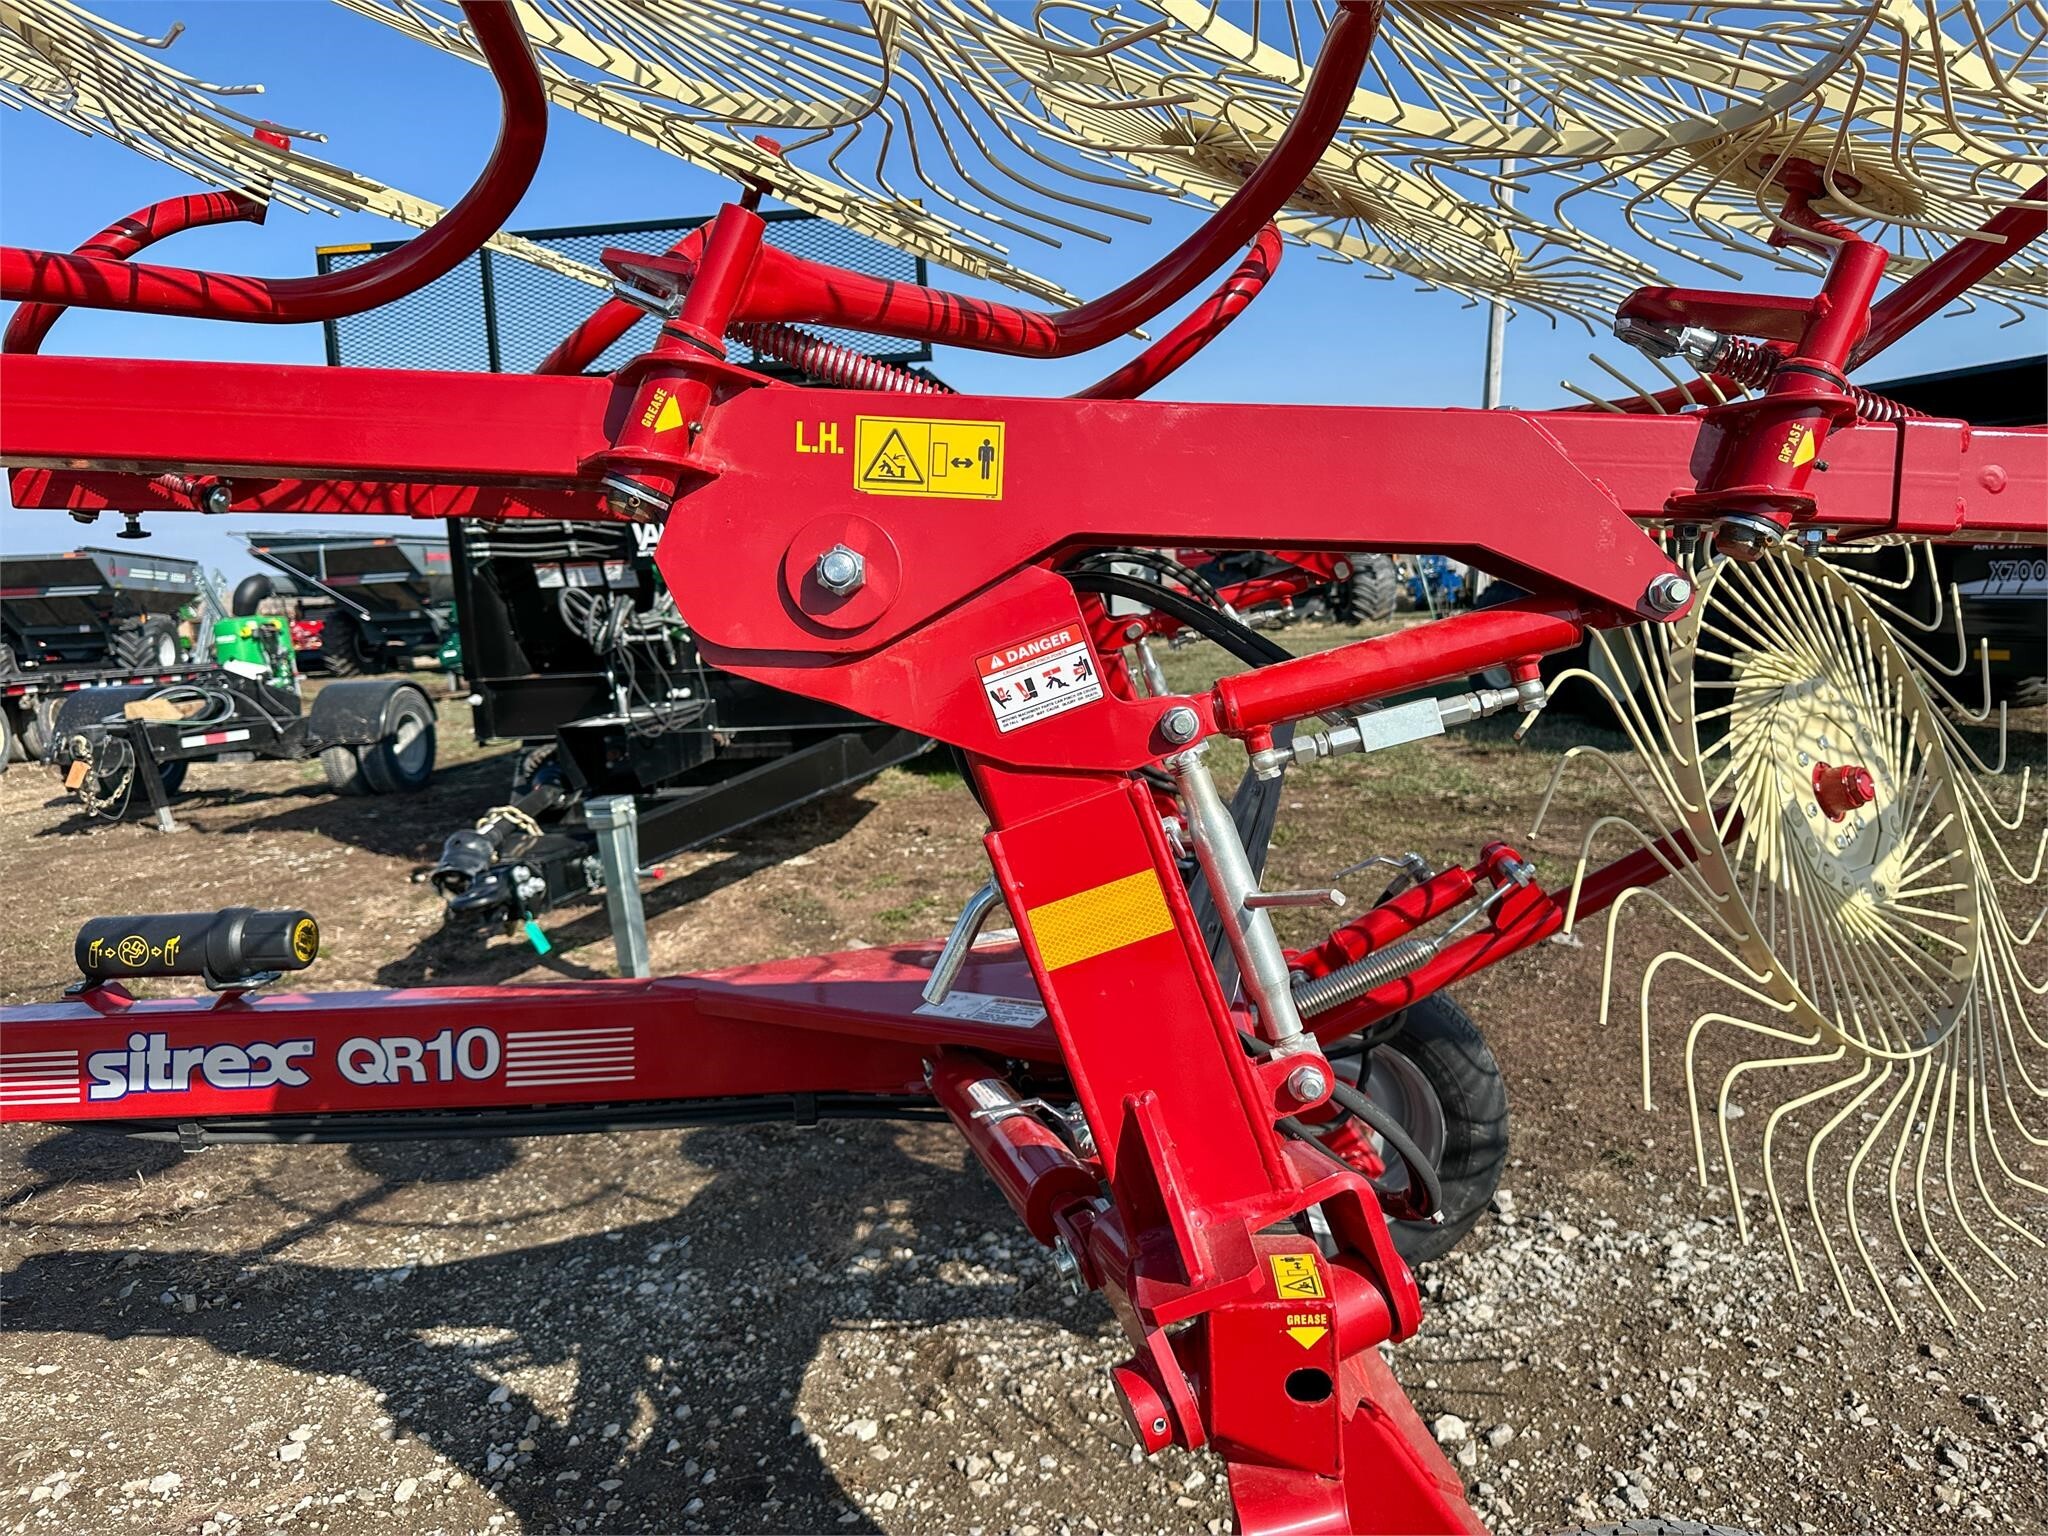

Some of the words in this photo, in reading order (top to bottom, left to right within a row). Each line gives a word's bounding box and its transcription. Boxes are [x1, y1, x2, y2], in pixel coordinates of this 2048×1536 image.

[641, 388, 667, 428] GREASE
[796, 421, 844, 454] L.H.
[1006, 631, 1071, 663] DANGER
[1001, 715, 1017, 723] MOVING
[1018, 707, 1041, 717] MACHINERY
[89, 1032, 314, 1100] sitrex
[337, 1027, 500, 1084] QR10
[1287, 1314, 1327, 1325] GREASE
